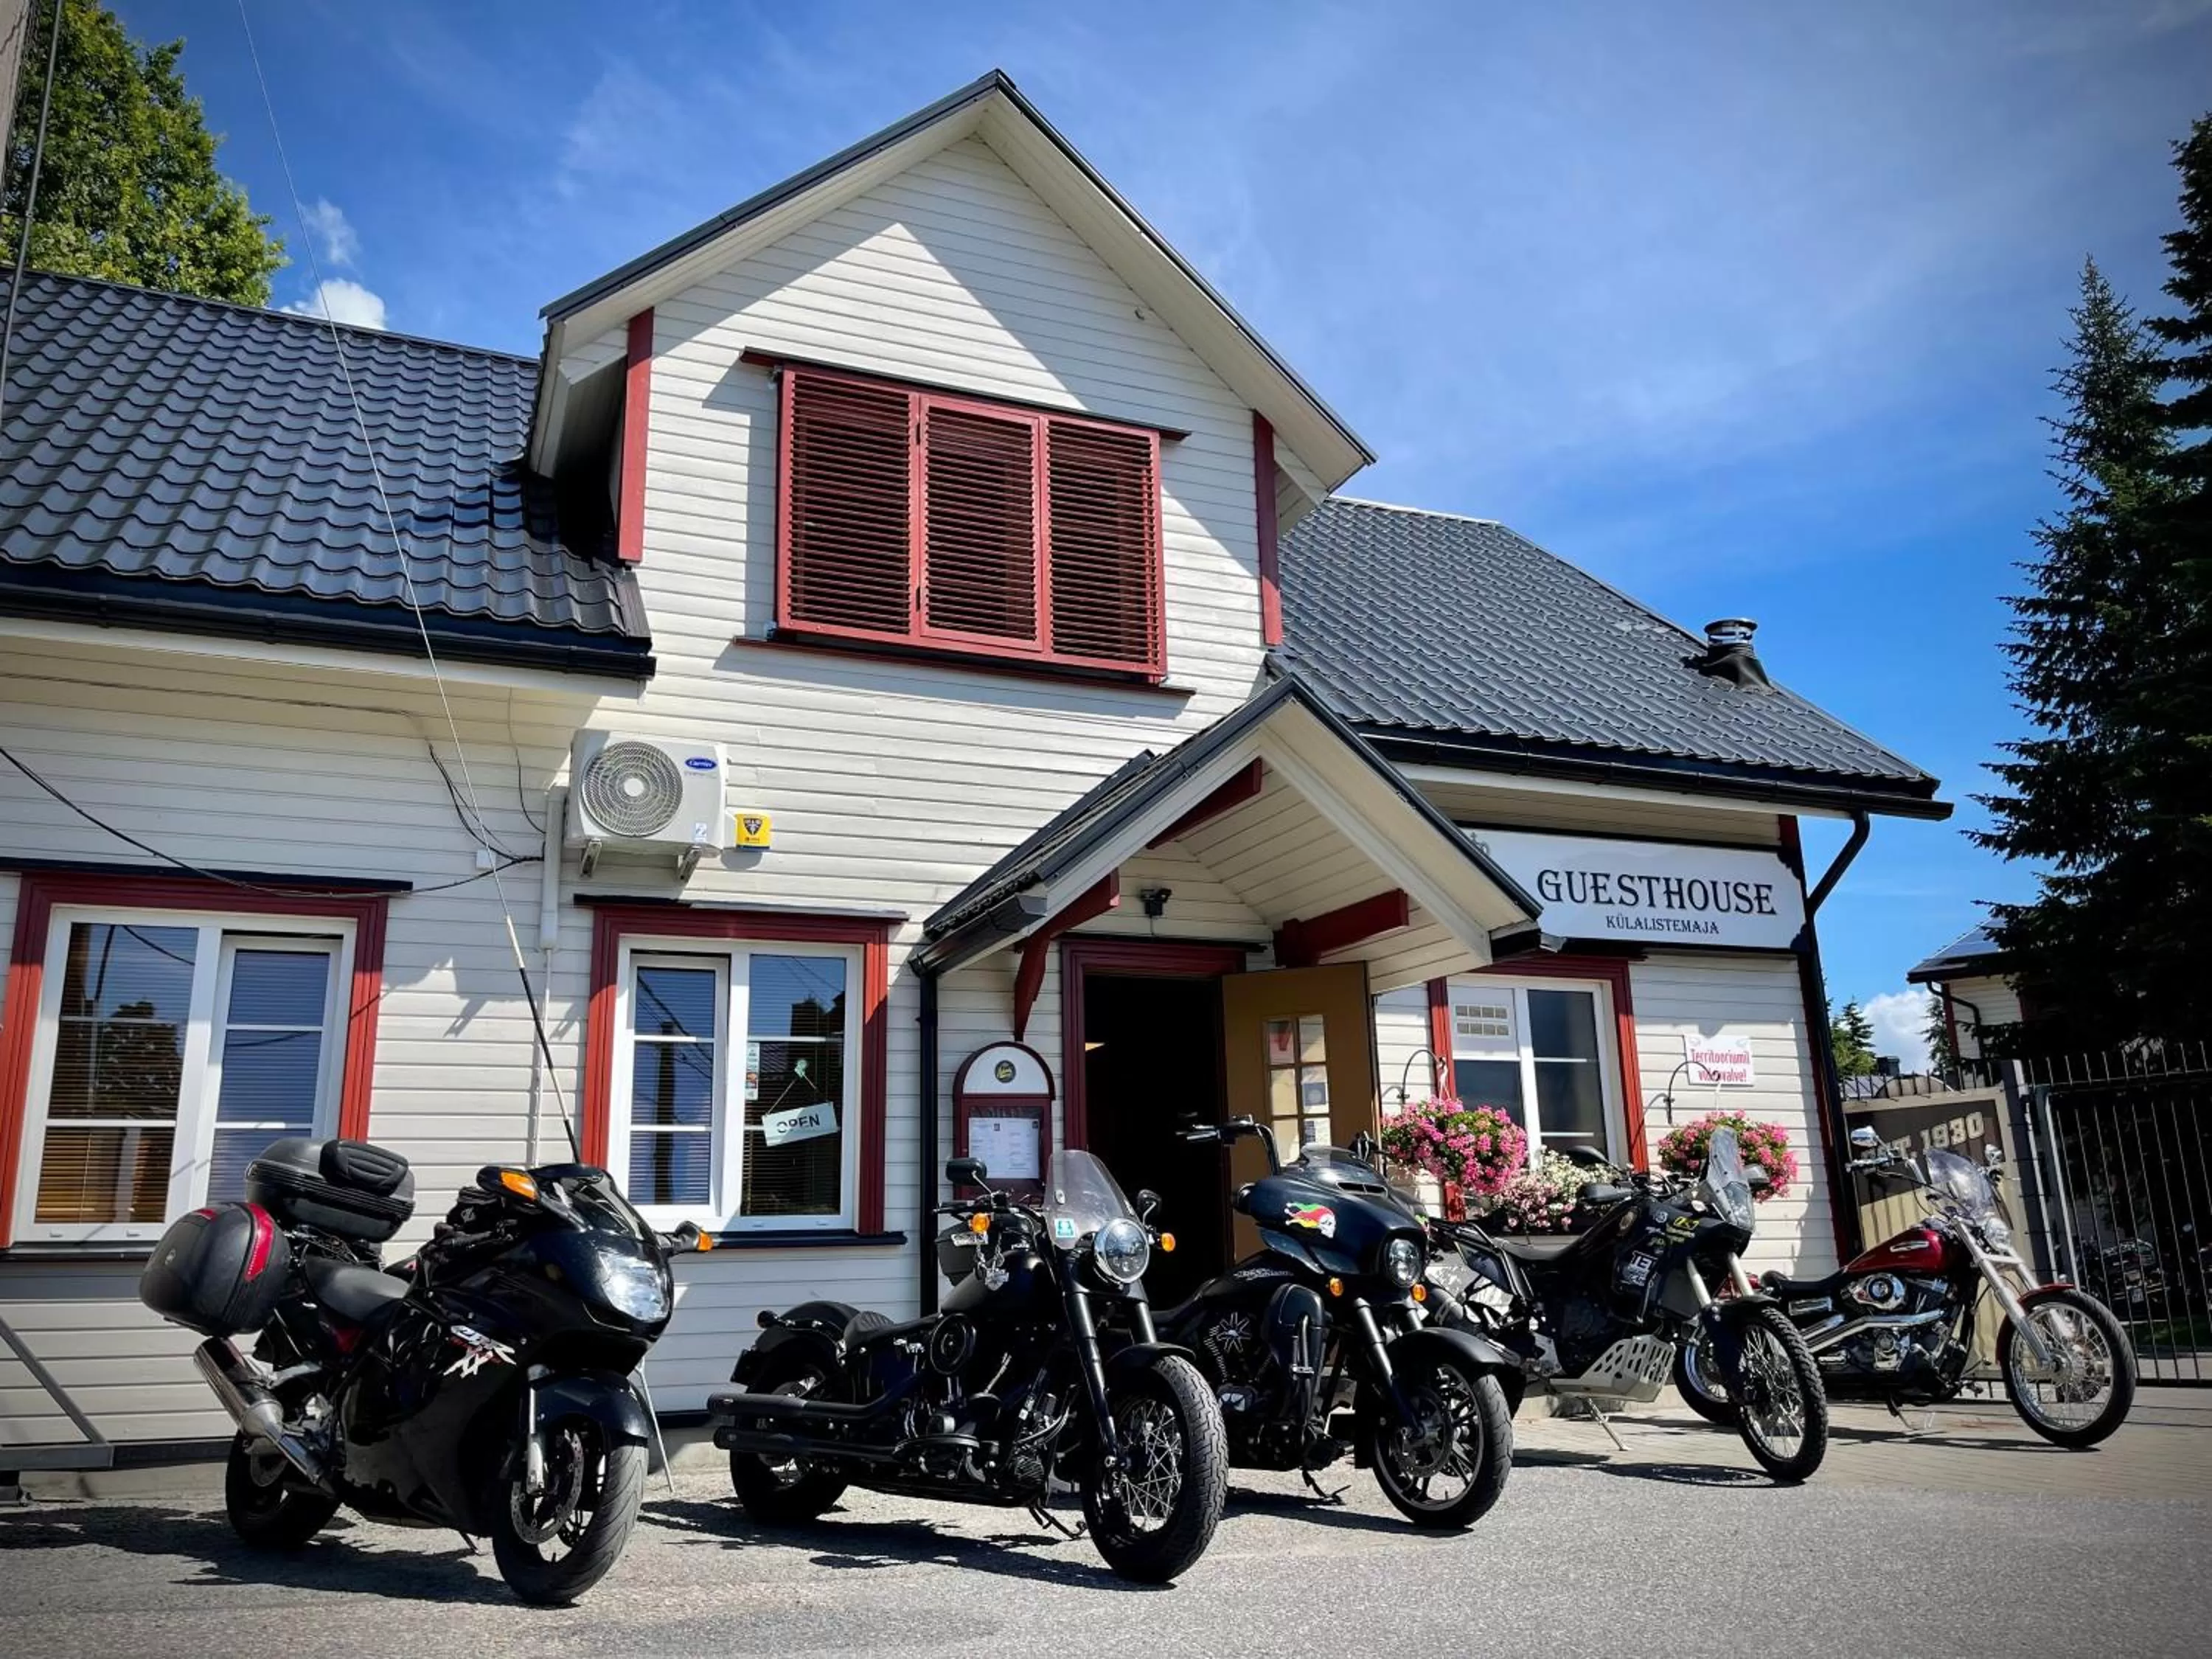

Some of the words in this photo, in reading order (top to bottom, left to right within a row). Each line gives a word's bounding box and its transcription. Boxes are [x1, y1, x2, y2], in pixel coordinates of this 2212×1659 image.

[1537, 869, 1777, 916] GUESTHOUSE
[1605, 914, 1720, 935] KÜLALISTEMAJA
[776, 1113, 820, 1133] OPEN
[1919, 1111, 1985, 1152] 1930
